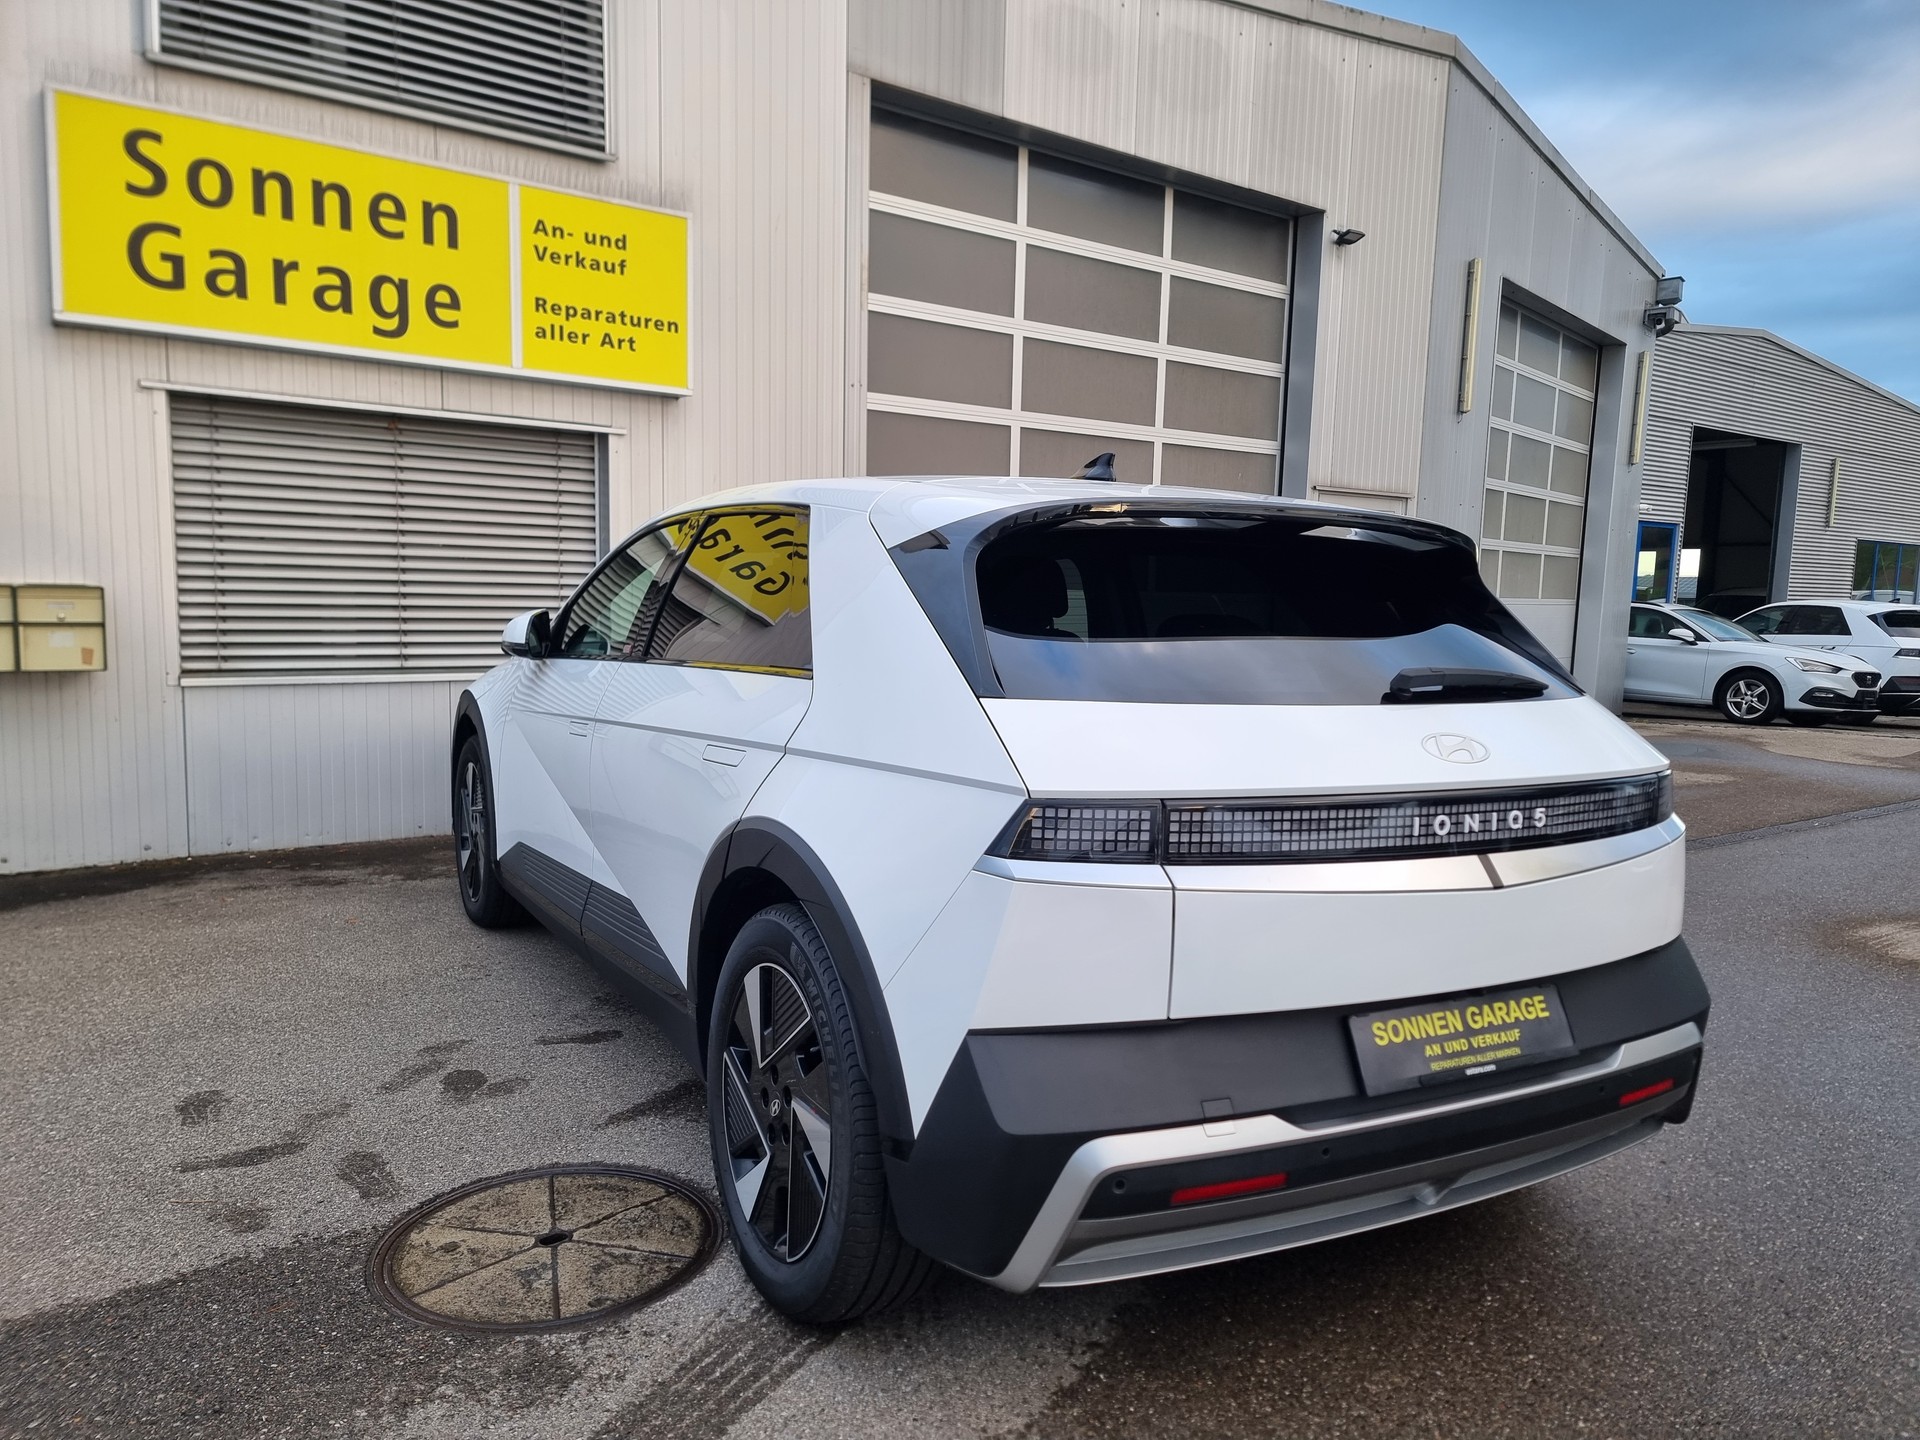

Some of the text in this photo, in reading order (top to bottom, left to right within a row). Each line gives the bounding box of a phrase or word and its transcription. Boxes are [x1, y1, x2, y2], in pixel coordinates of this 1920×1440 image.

[122, 128, 460, 250] Sonnen
[533, 218, 628, 251] An- und
[533, 244, 628, 276] Verkauf
[125, 222, 462, 339] Garage
[534, 296, 680, 334] Reparaturen
[534, 323, 637, 352] aller Art
[1412, 807, 1547, 837] IONIQ 5
[1371, 995, 1550, 1046] SONNEN GARAGE
[1424, 1028, 1521, 1057] AN UND VERKAUF
[1431, 1056, 1476, 1071] REPARATUREN
[1477, 1051, 1496, 1062] ALLER
